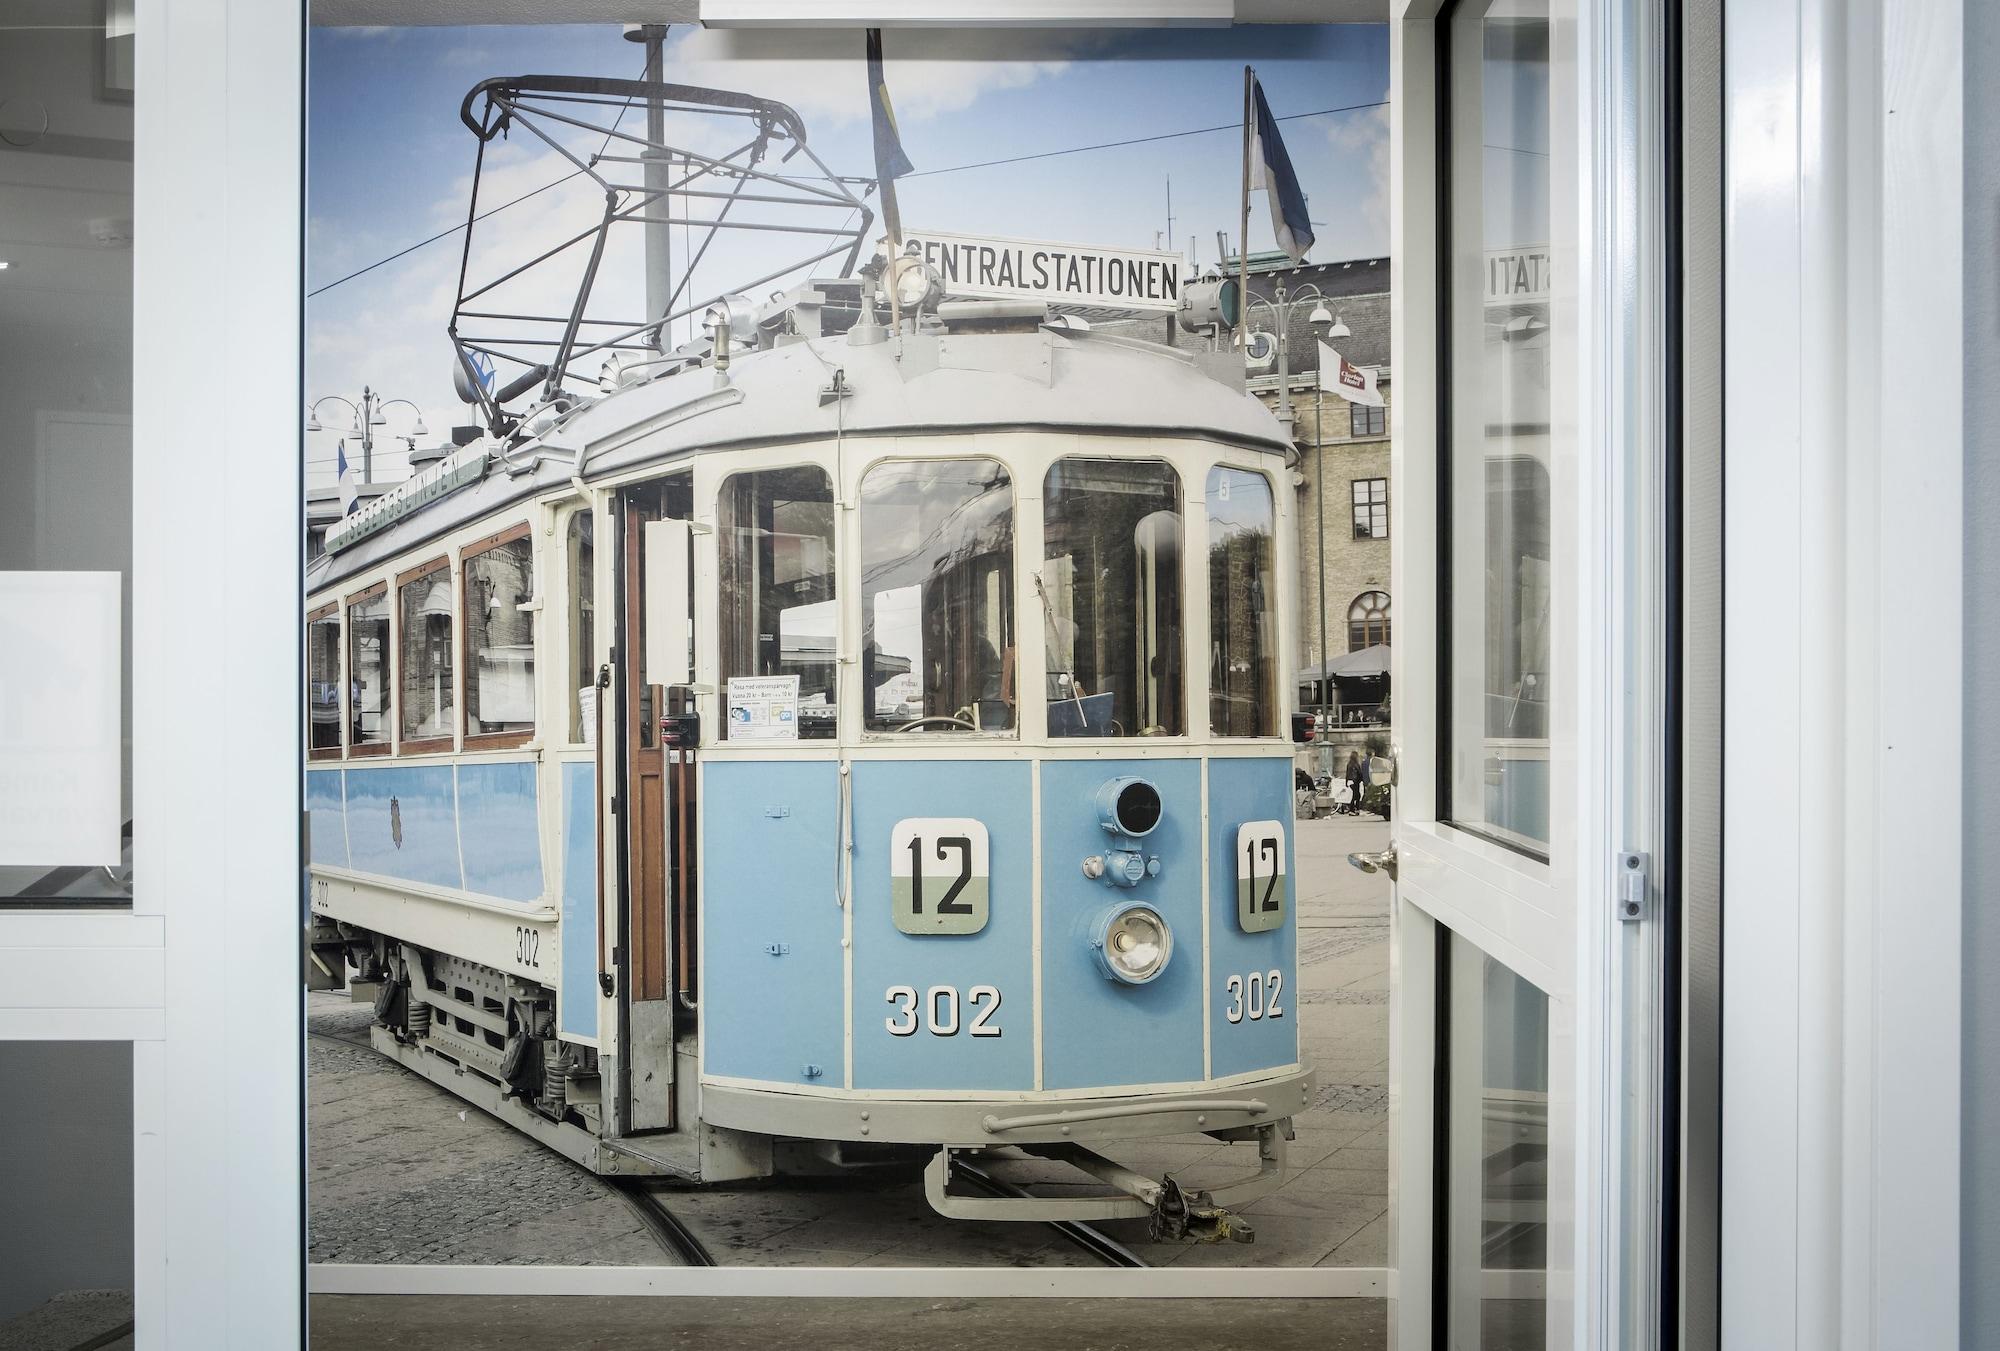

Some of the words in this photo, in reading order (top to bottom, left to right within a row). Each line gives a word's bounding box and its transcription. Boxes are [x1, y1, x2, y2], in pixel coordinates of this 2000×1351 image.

[907, 836, 973, 915] 12
[1246, 837, 1279, 915] 12
[515, 925, 540, 968] 302
[885, 984, 1002, 1038] 302
[1226, 968, 1284, 1024] 302
